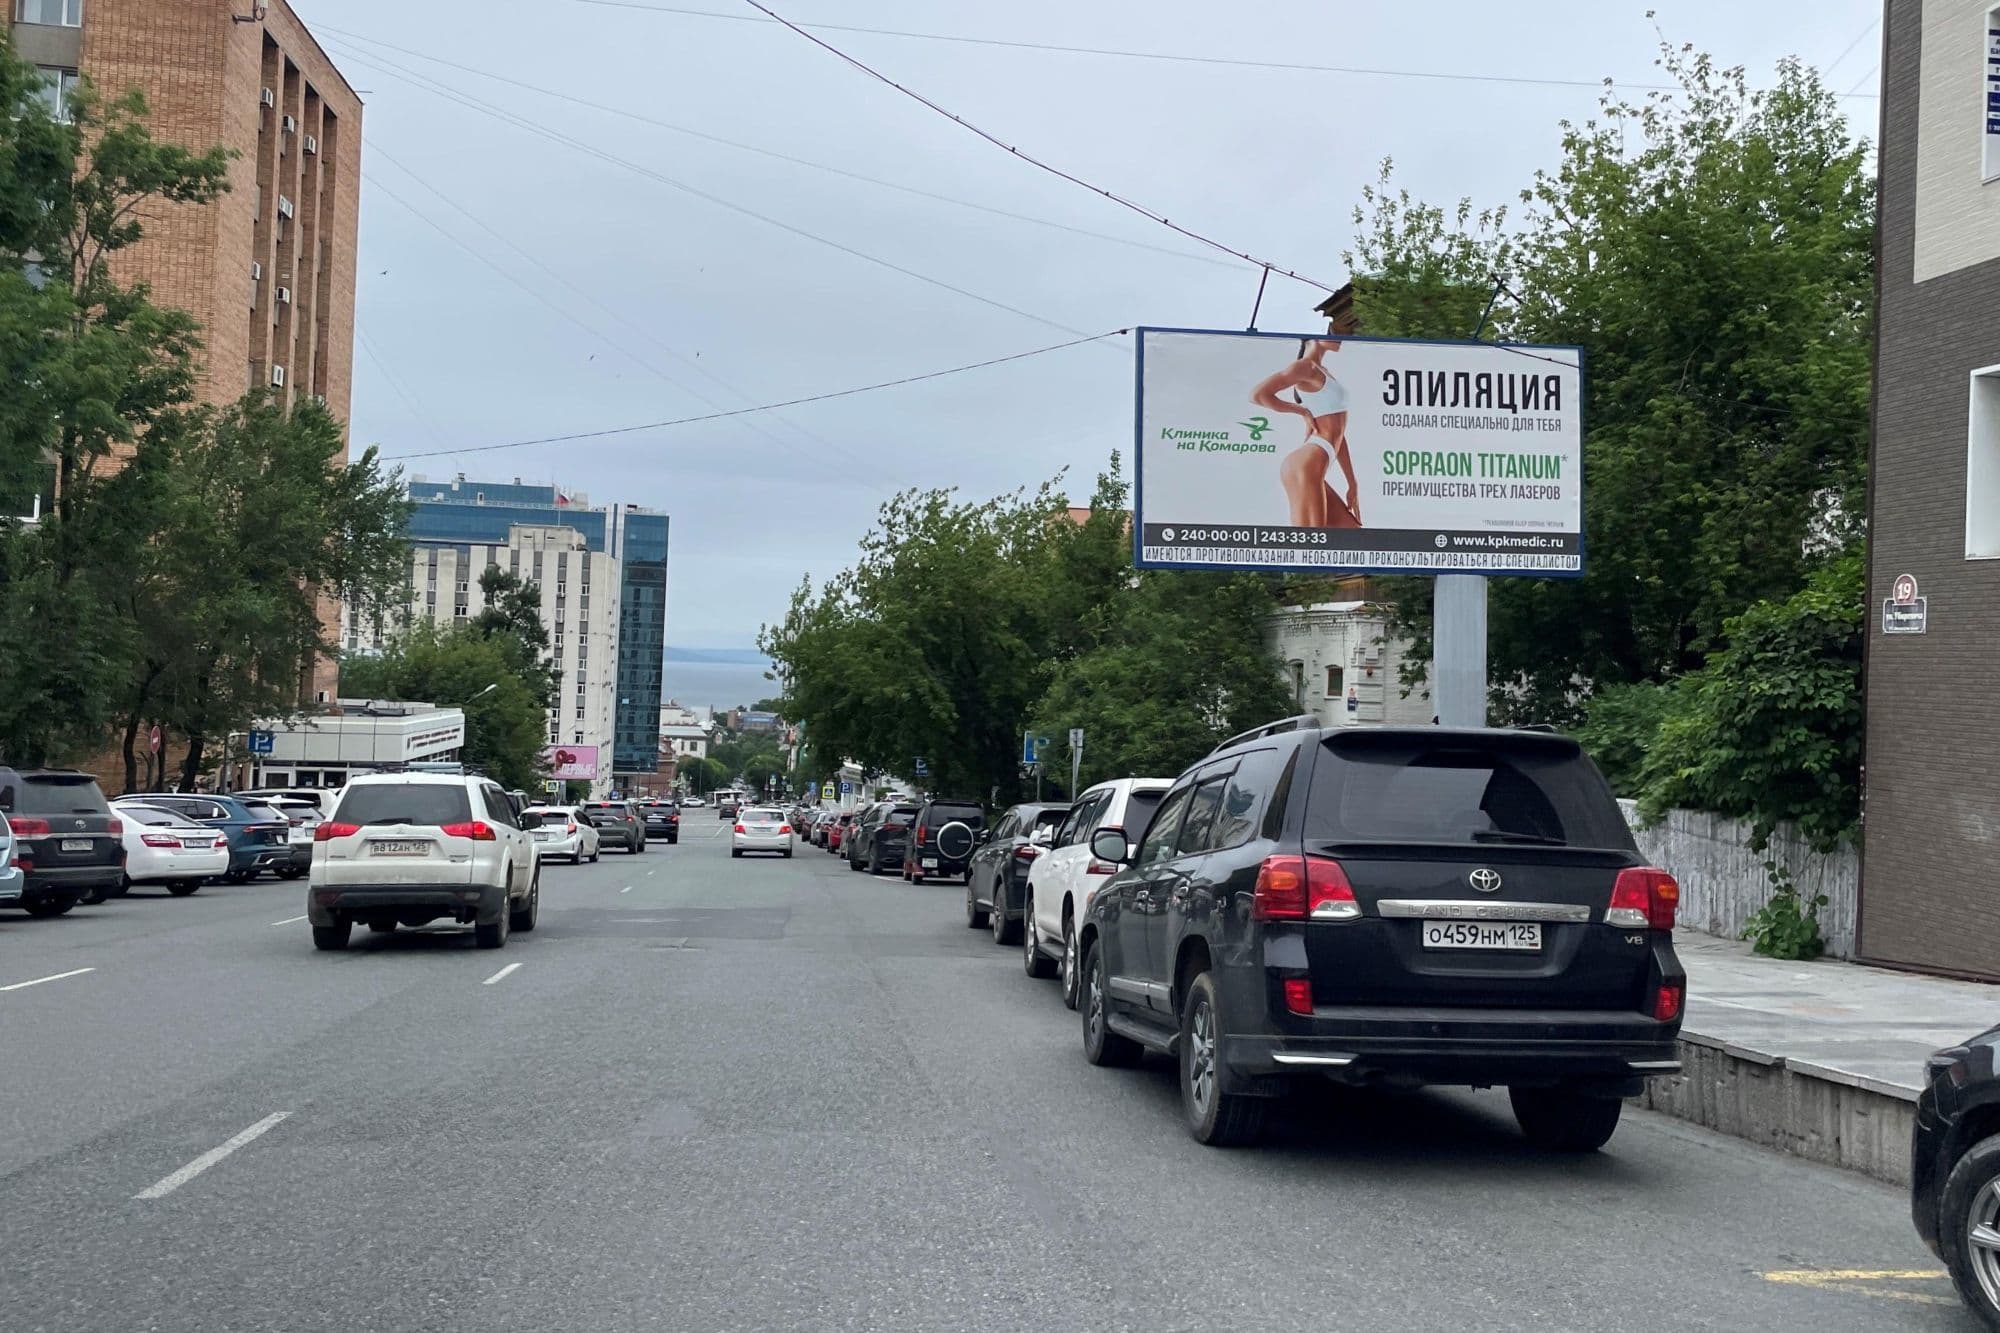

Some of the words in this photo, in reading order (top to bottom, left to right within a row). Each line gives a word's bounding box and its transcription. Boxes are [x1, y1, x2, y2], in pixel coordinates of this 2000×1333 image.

[1383, 369, 1561, 414] ЭПИЛЯЦИЯ
[1382, 413, 1438, 429] СОЗДАНАЯ
[1441, 415, 1509, 431] СПЕЦИАЛЬНО
[1512, 417, 1533, 432] ДЛЯ
[1537, 418, 1561, 432] ТЕБЯ
[1161, 428, 1229, 440] Клиника
[1177, 442, 1195, 450] на
[1199, 440, 1276, 454] Комарова
[1383, 450, 1472, 477] SOPRAON
[1382, 481, 1476, 499] ПРЕИМУЩЕСТВА
[1479, 483, 1507, 499] ТРЕХ
[1510, 485, 1561, 500] ЛАЗЕРОВ
[1453, 536, 1564, 549] www.kpkmedic.ru
[1146, 548, 1192, 561] ИМЕЮТСЯ
[1302, 550, 1365, 565] НЕОБХОДИМО
[1369, 552, 1488, 568] ПРОКОНСУЛЬТИРОВАТЬСЯ
[1491, 554, 1502, 567] СО
[1506, 555, 1578, 569] СПЕЦИАЛИСТОМ
[1897, 583, 1911, 600] 19
[1509, 925, 1536, 941] 125
